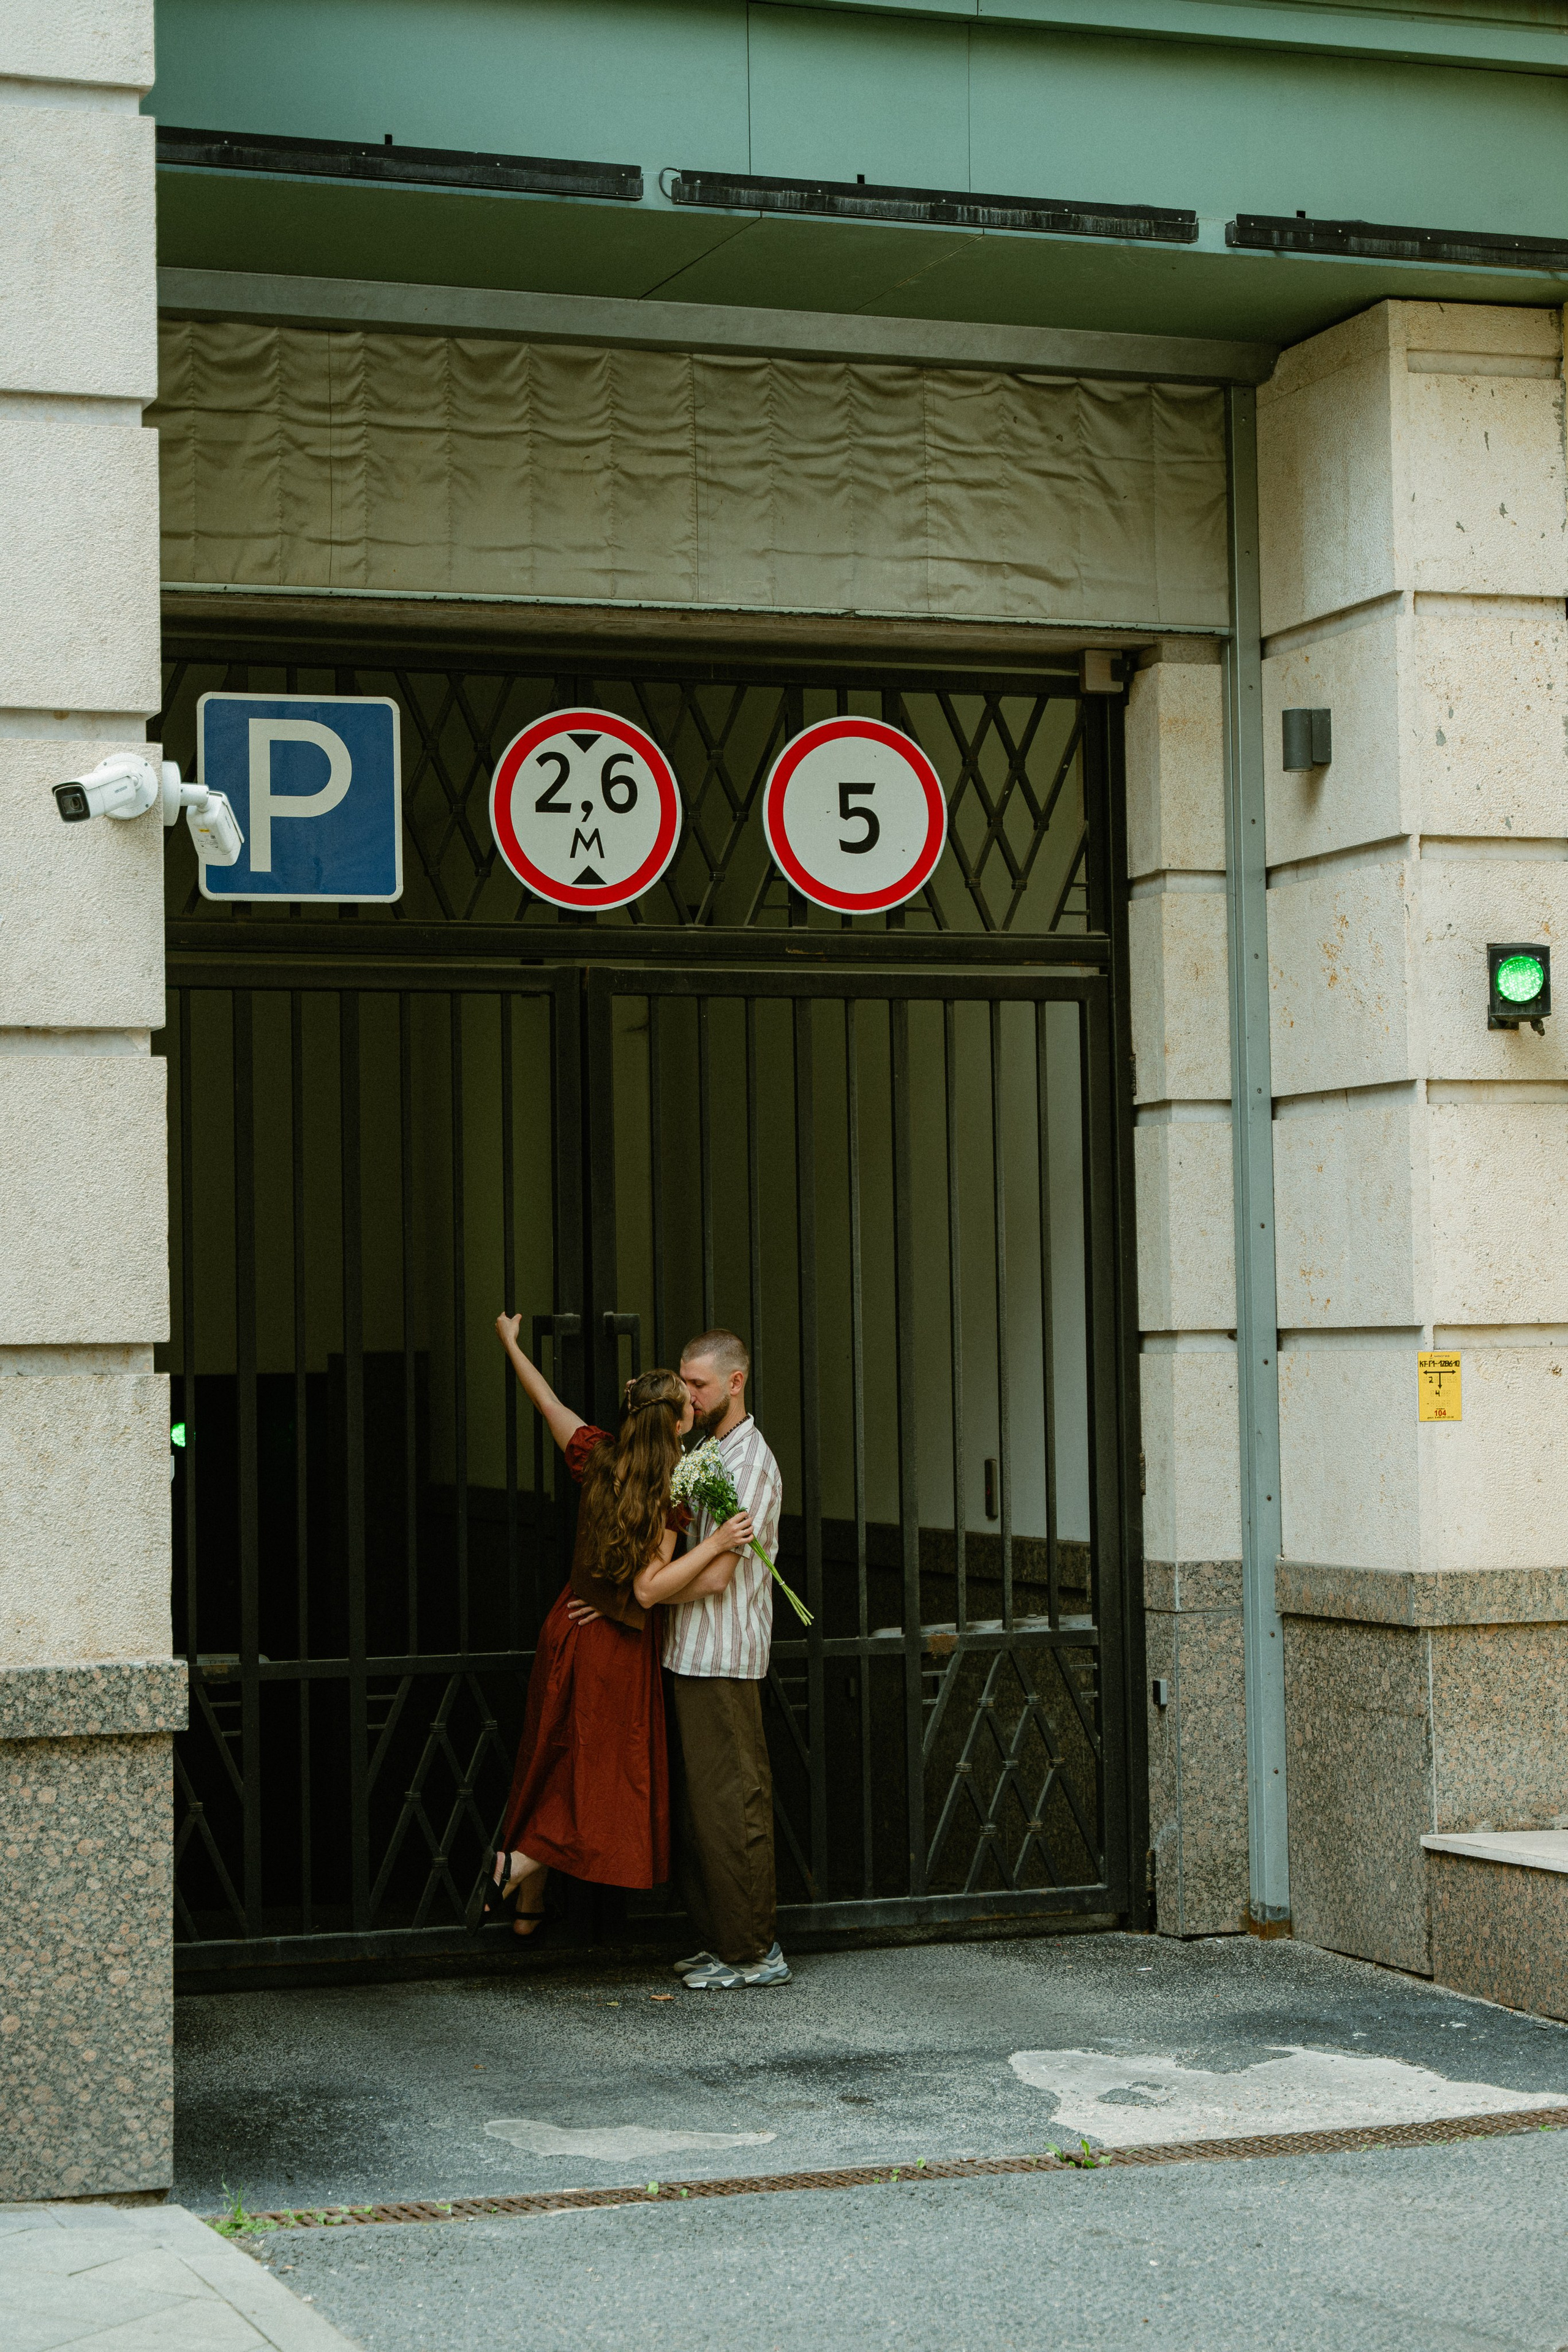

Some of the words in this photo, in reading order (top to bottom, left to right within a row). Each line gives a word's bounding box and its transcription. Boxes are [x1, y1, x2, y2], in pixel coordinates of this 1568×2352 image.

[249, 718, 352, 872] P
[535, 751, 638, 823] 2,6
[839, 782, 880, 854] 5
[570, 827, 605, 859] М
